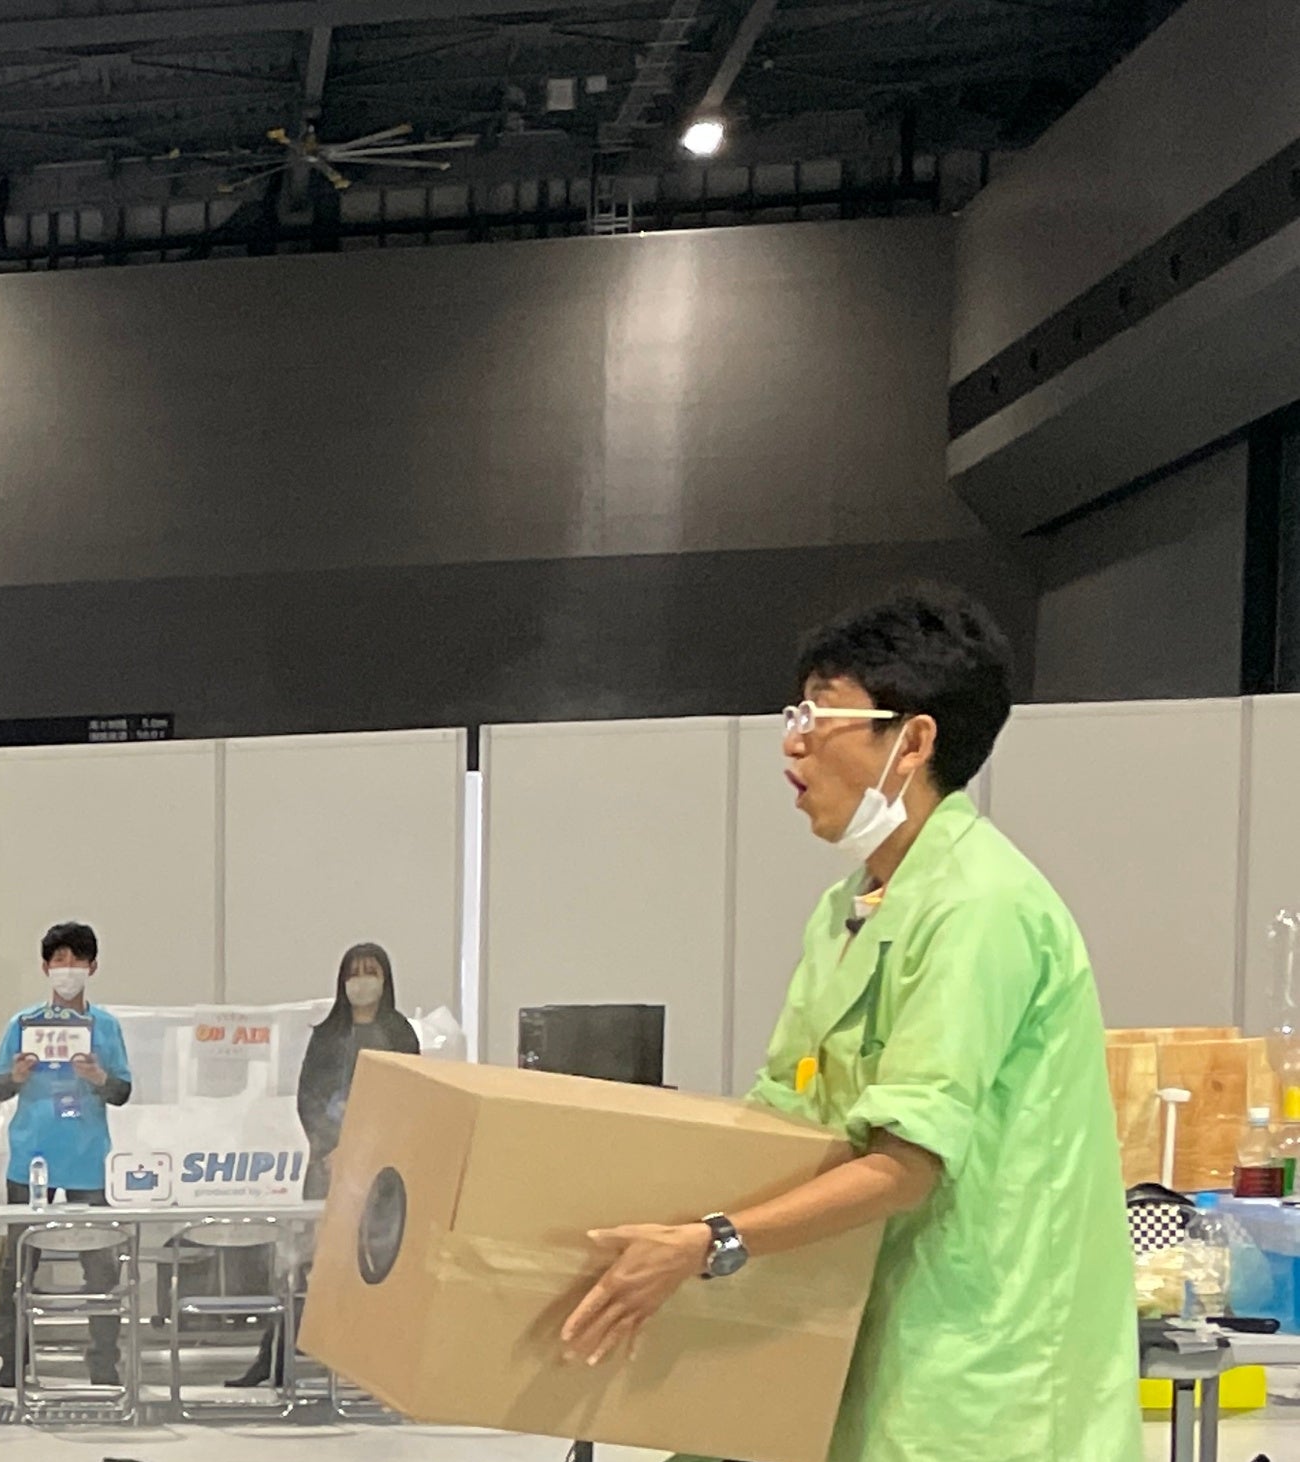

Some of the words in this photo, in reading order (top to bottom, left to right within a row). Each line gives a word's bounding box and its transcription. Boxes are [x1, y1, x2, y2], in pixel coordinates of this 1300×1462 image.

[195, 1024, 226, 1042] ON
[232, 1026, 271, 1045] AIR
[181, 1151, 303, 1183] SHIP!!
